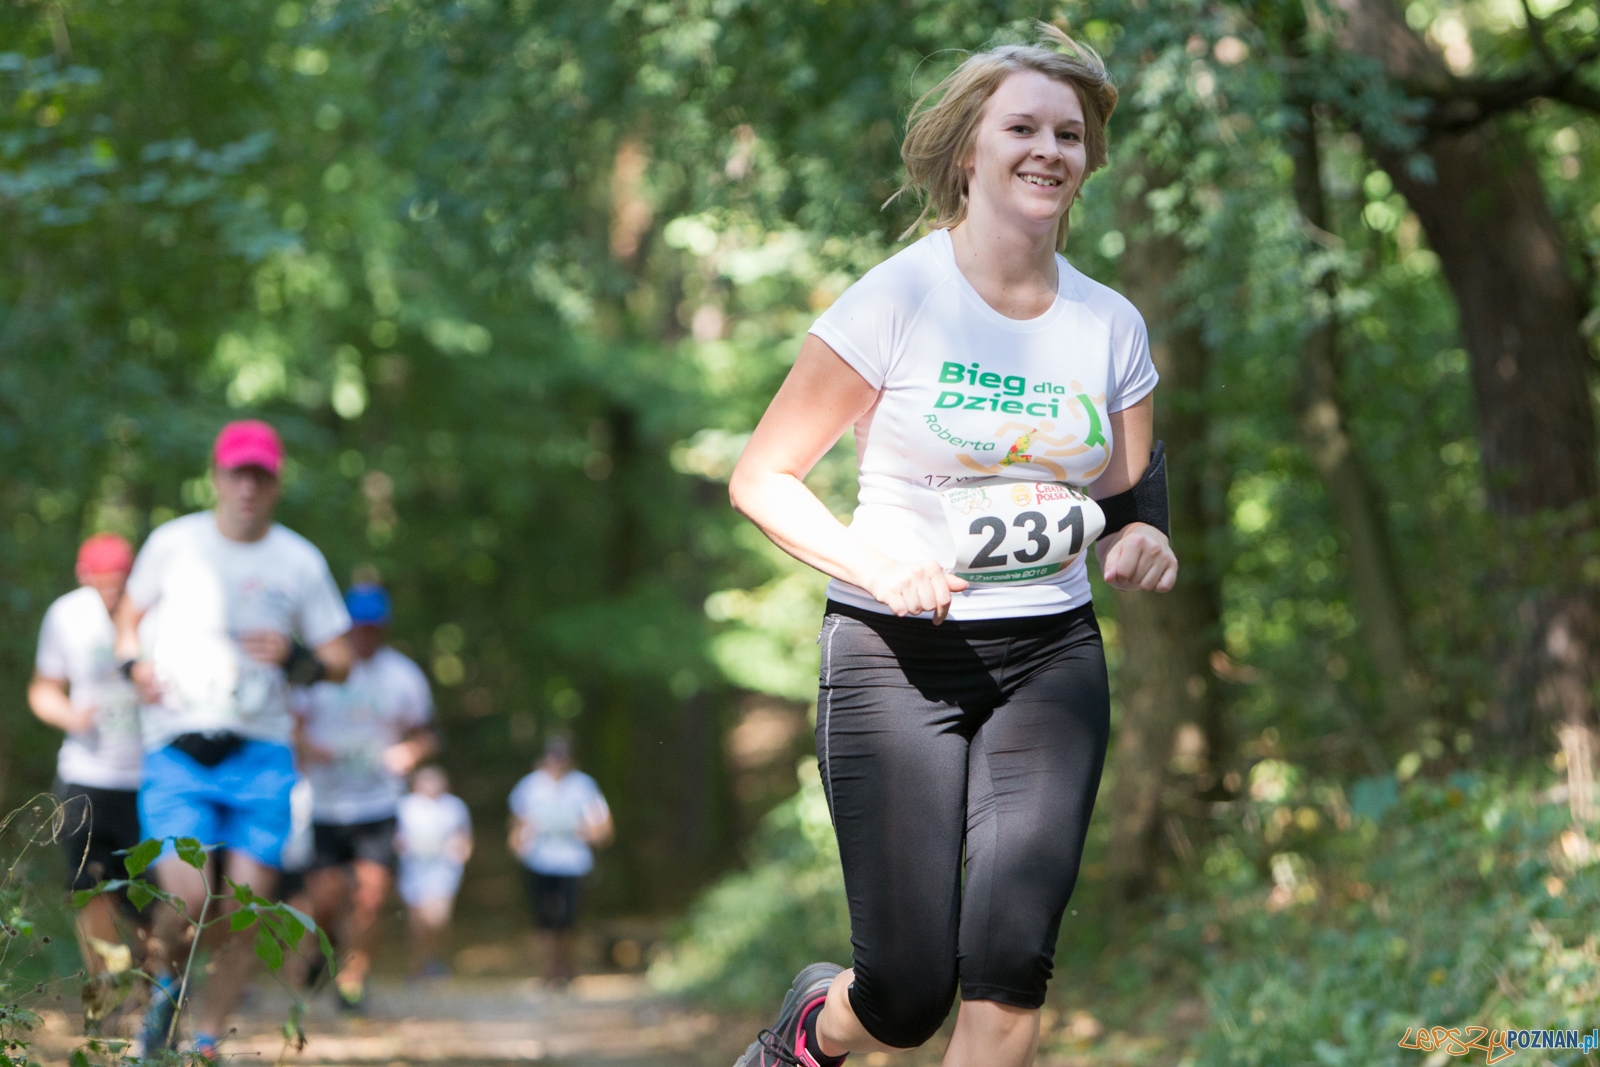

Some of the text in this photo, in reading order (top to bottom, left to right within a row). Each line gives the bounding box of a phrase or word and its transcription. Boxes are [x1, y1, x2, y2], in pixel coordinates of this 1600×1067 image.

[938, 361, 1065, 396] Bieg dla
[933, 391, 1060, 418] Dzieci
[924, 413, 995, 451] Roberta
[924, 474, 951, 487] 17
[1035, 493, 1070, 504] POLSKA
[968, 505, 1084, 569] 231
